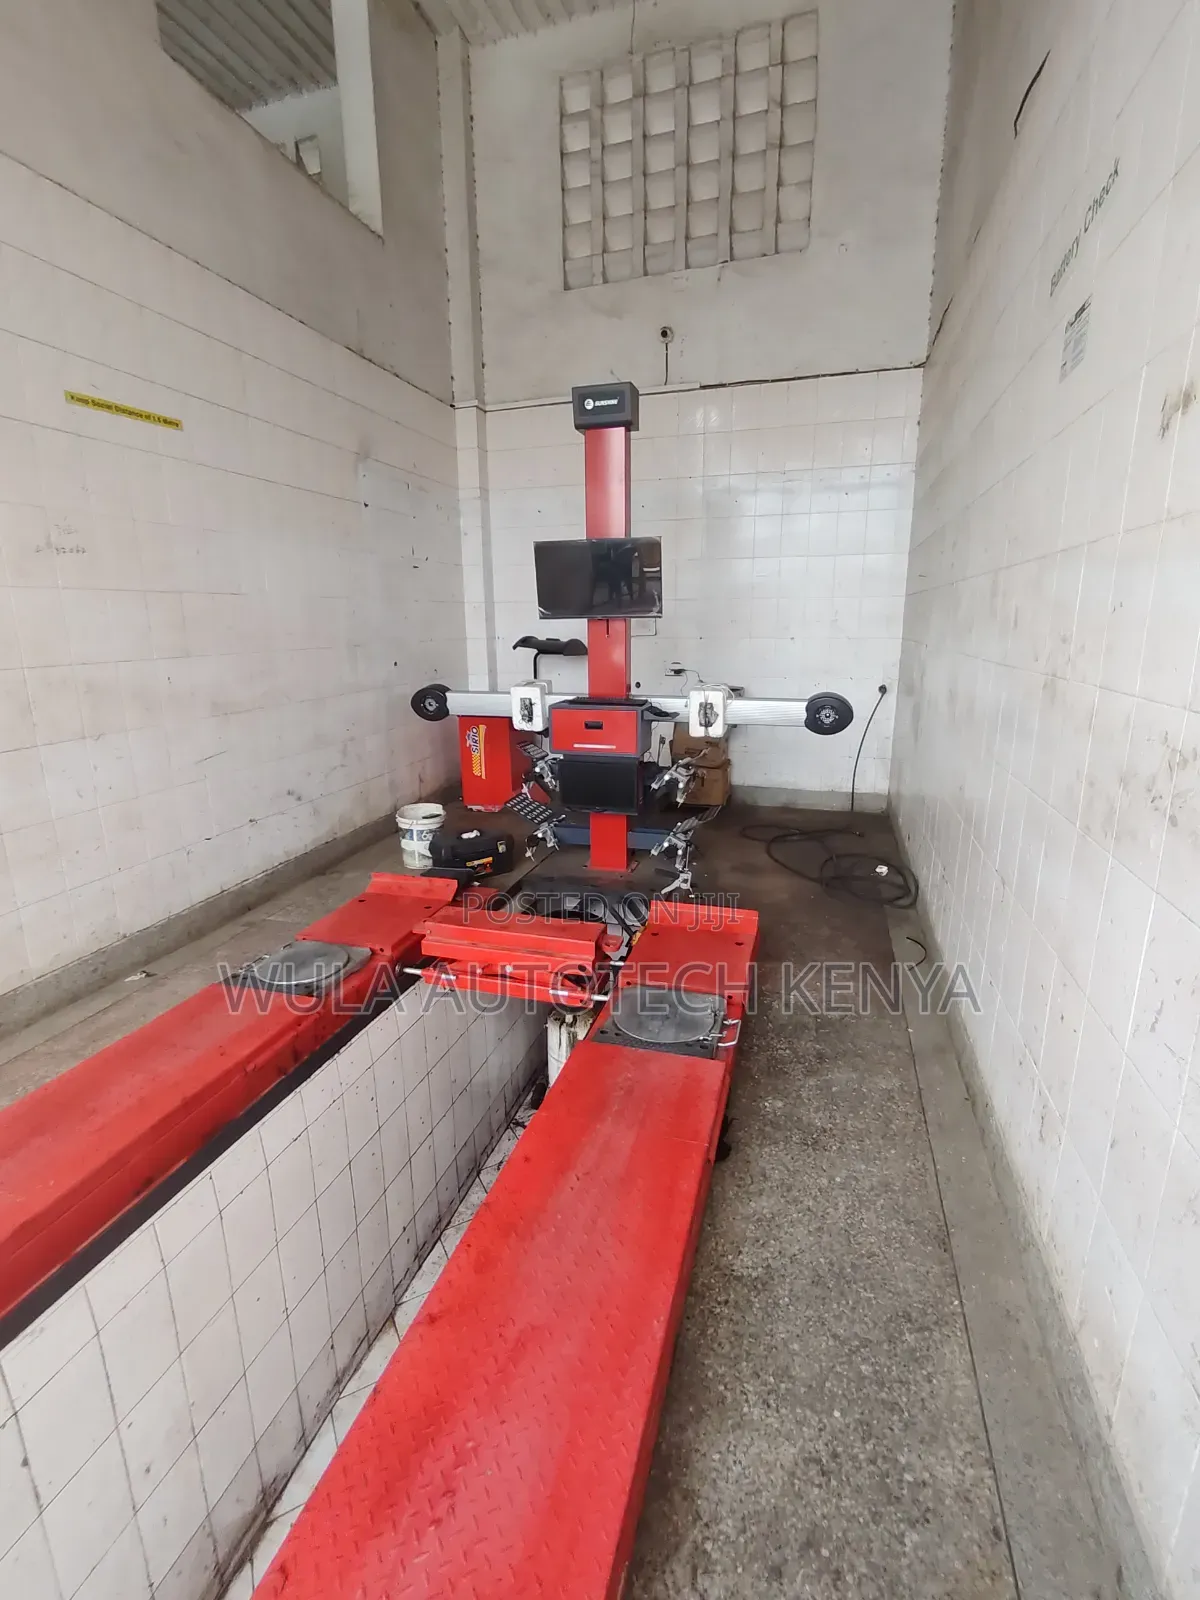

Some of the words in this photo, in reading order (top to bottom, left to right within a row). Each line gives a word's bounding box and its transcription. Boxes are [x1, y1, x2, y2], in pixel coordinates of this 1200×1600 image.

[1050, 228, 1081, 297] Battery
[1084, 157, 1120, 233] Check
[91, 399, 114, 411] Social
[114, 405, 144, 419] Distance
[471, 726, 479, 754] SIRIO
